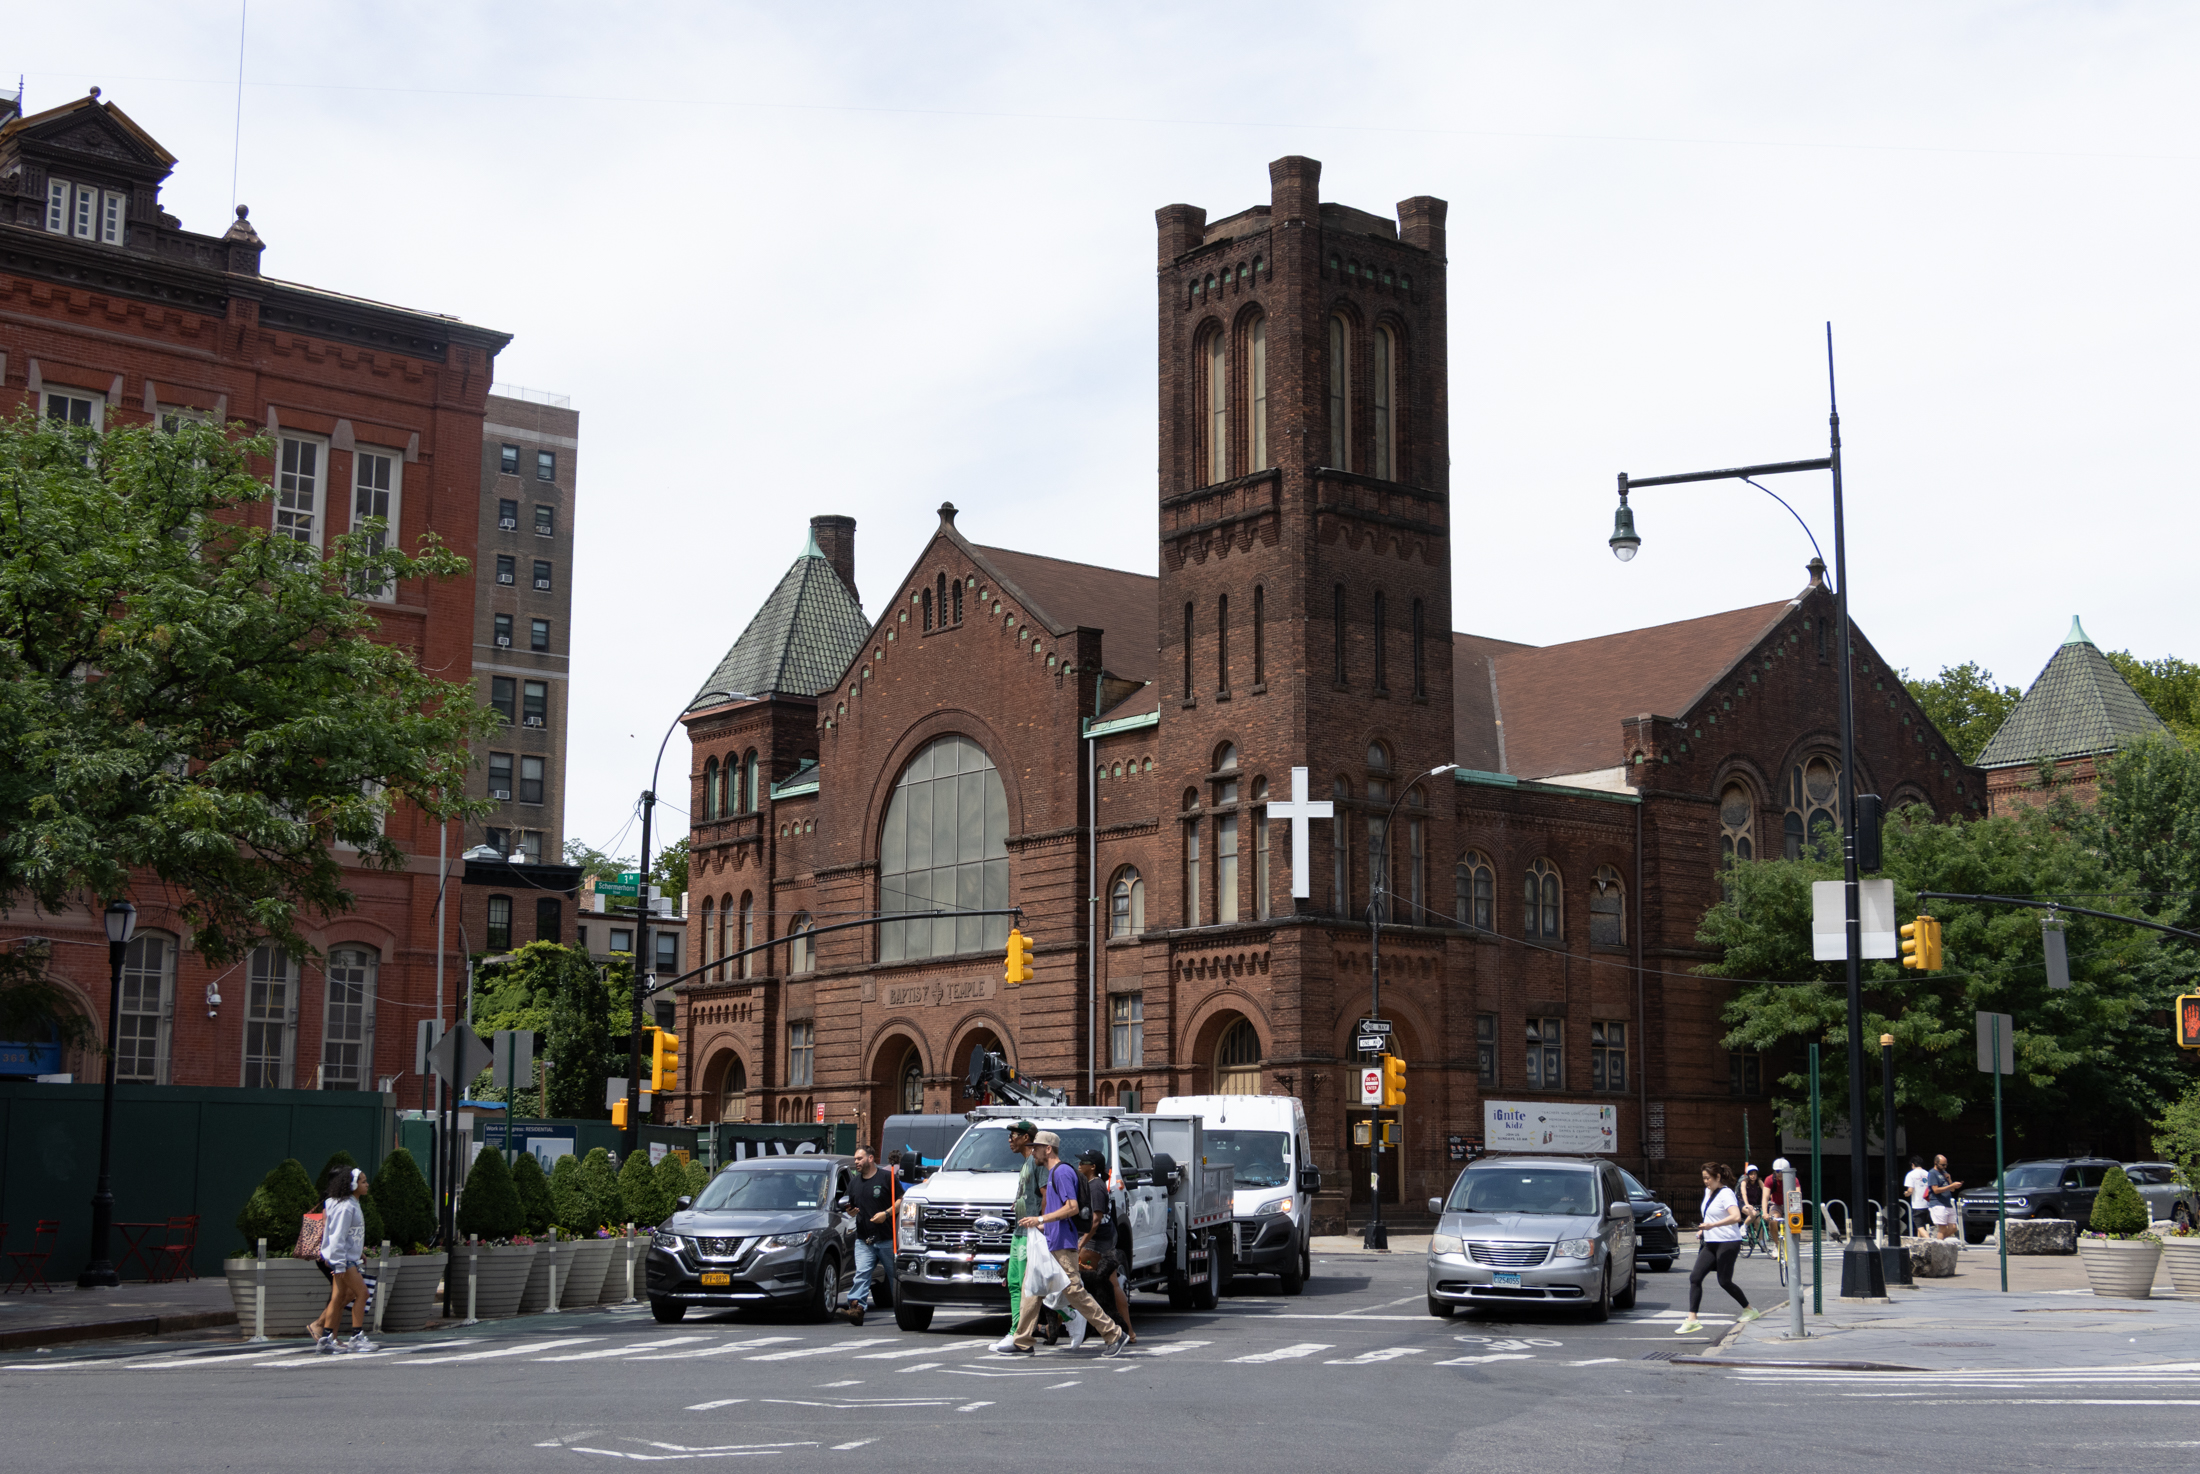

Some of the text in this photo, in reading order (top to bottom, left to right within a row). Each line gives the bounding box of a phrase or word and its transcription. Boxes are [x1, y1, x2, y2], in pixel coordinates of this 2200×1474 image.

[624, 875, 628, 884] 3
[598, 882, 636, 892] Schermerhorn
[890, 980, 986, 1005] BAPTIST TEMPLE
[2, 1053, 26, 1063] 362
[981, 1222, 1000, 1231] Ford
